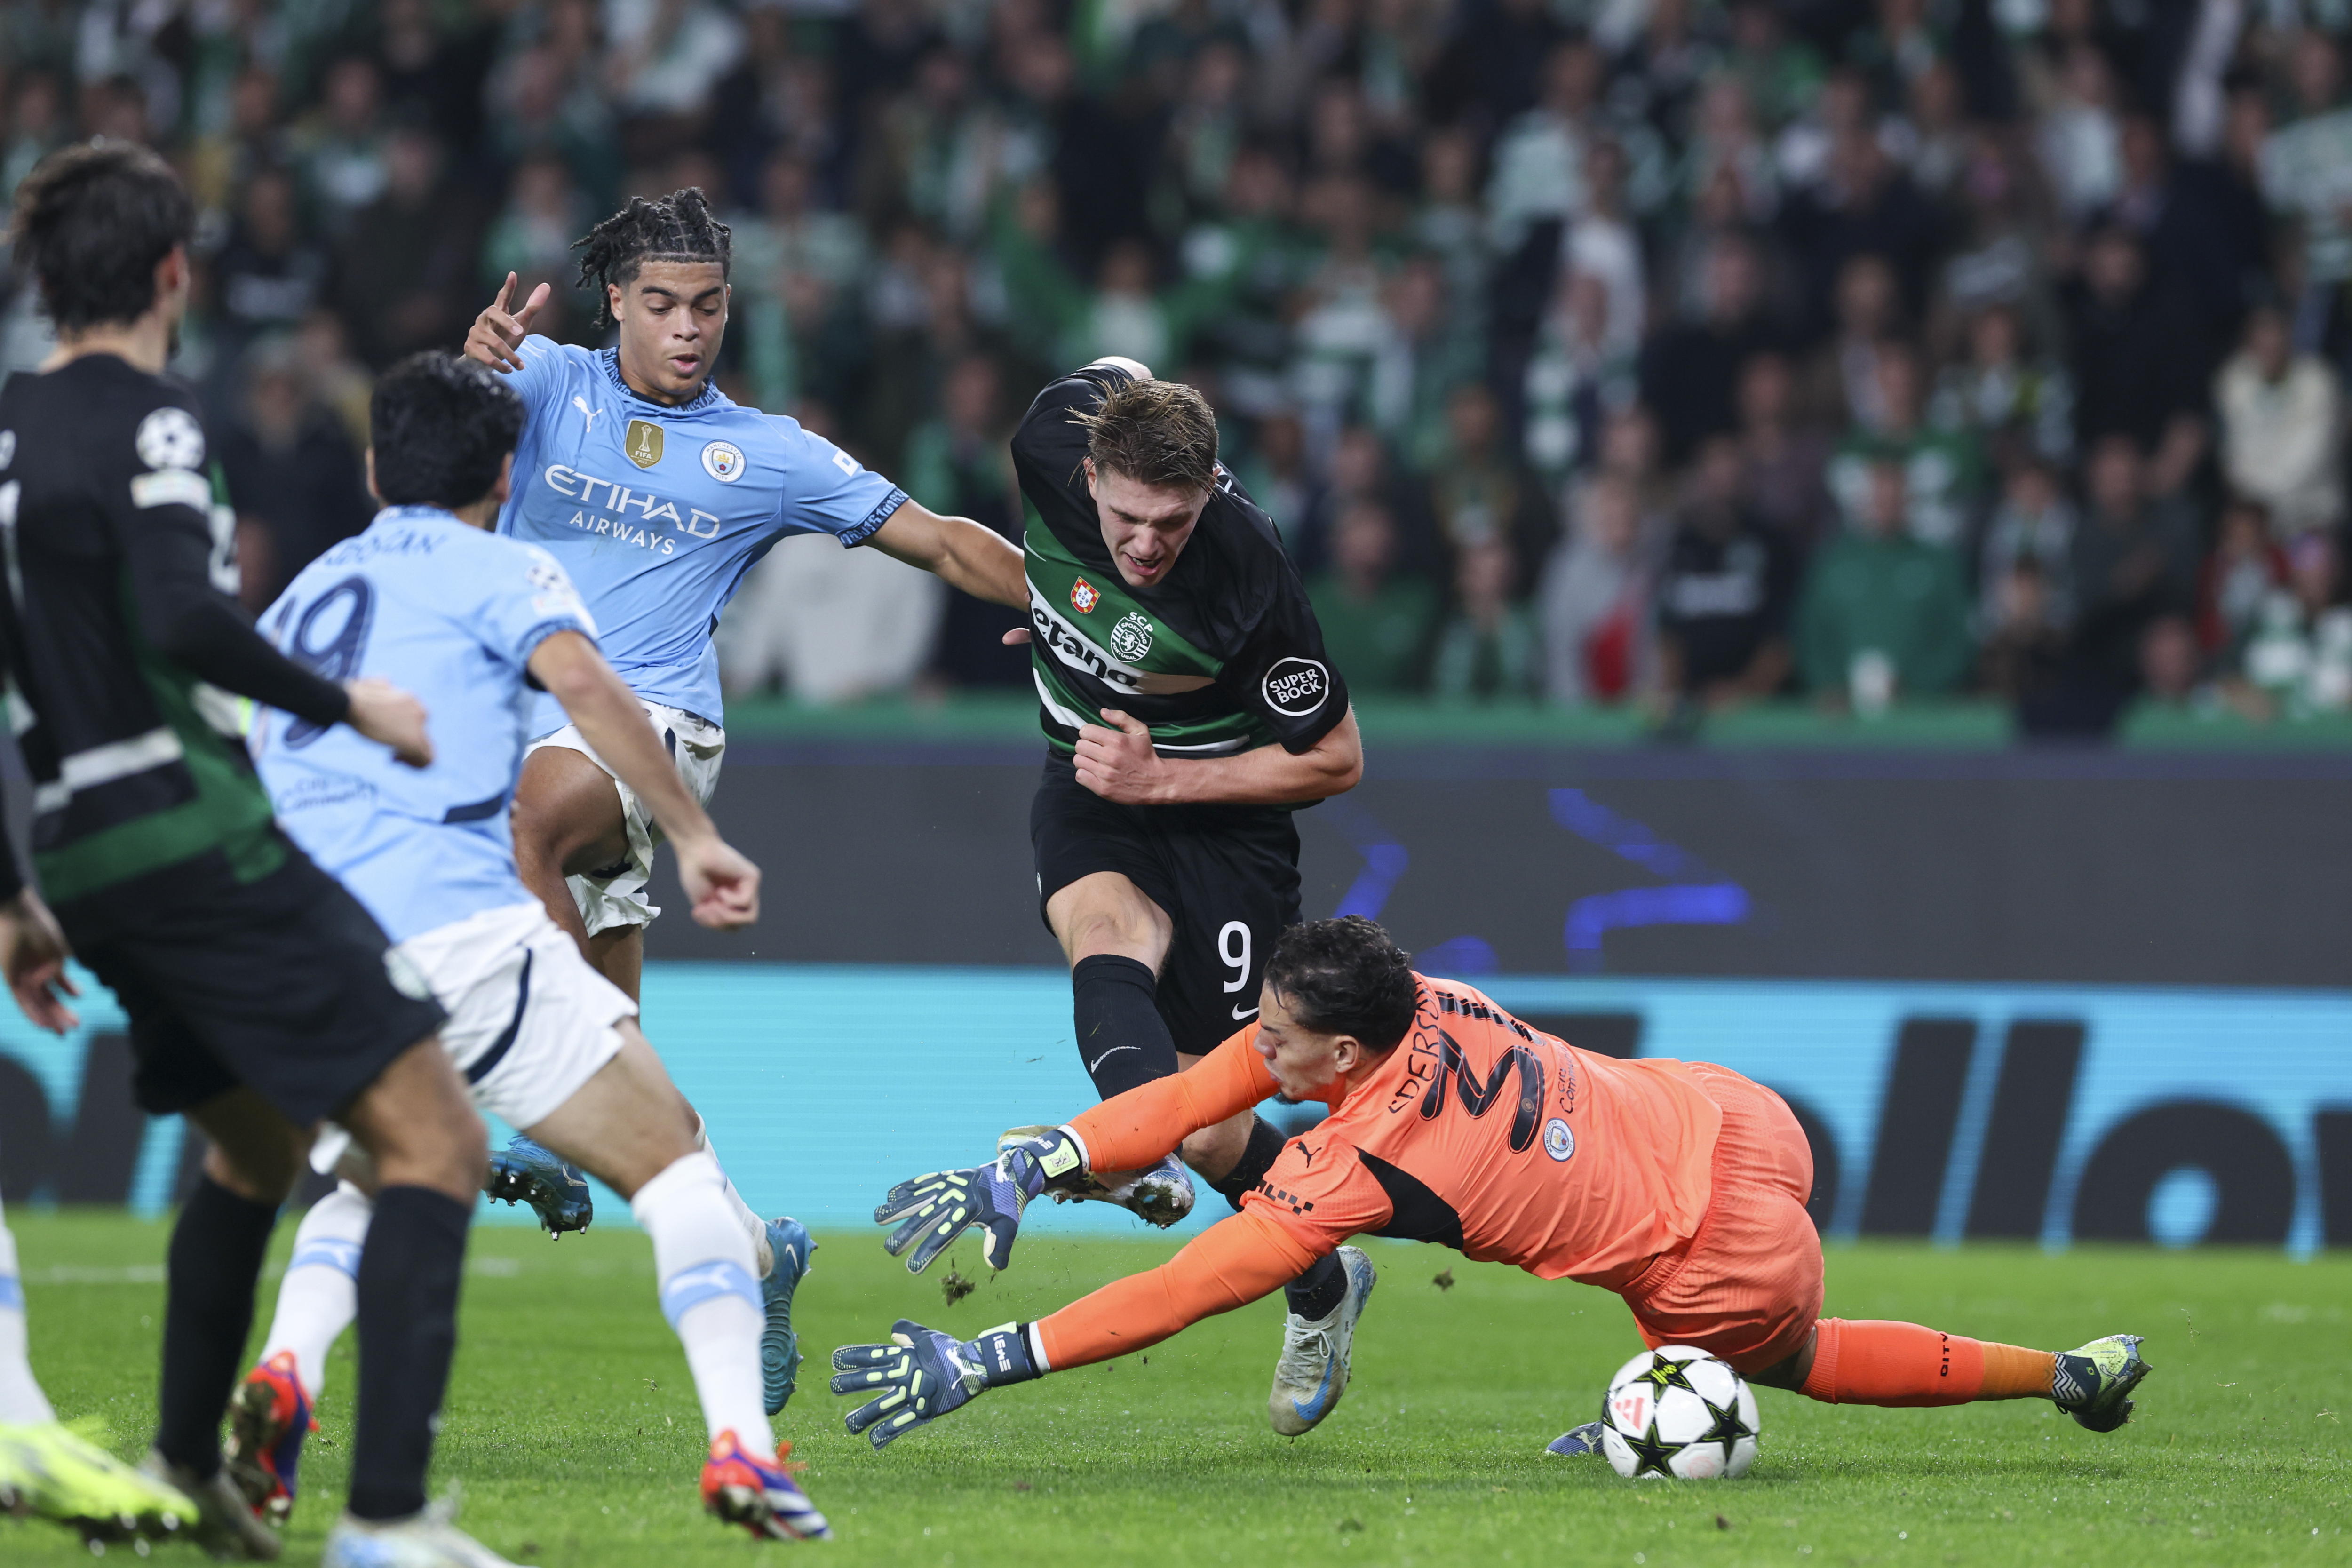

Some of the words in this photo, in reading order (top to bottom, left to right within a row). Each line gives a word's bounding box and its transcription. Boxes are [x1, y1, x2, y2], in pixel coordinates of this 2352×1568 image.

[635, 450, 652, 460] FIFA
[706, 443, 742, 460] MANCHESTER
[545, 464, 720, 539] ETIHAD
[569, 510, 675, 555] AIRWAYS
[1121, 622, 1147, 644] SPORTING
[1129, 612, 1153, 632] SCP
[1029, 594, 1137, 686] etano
[1112, 642, 1137, 660] PORTUGAL
[1269, 669, 1319, 693] SUPER
[1277, 678, 1323, 704] BOCK
[1218, 921, 1251, 993] 9
[1545, 1121, 1557, 1153] MANCHESTER
